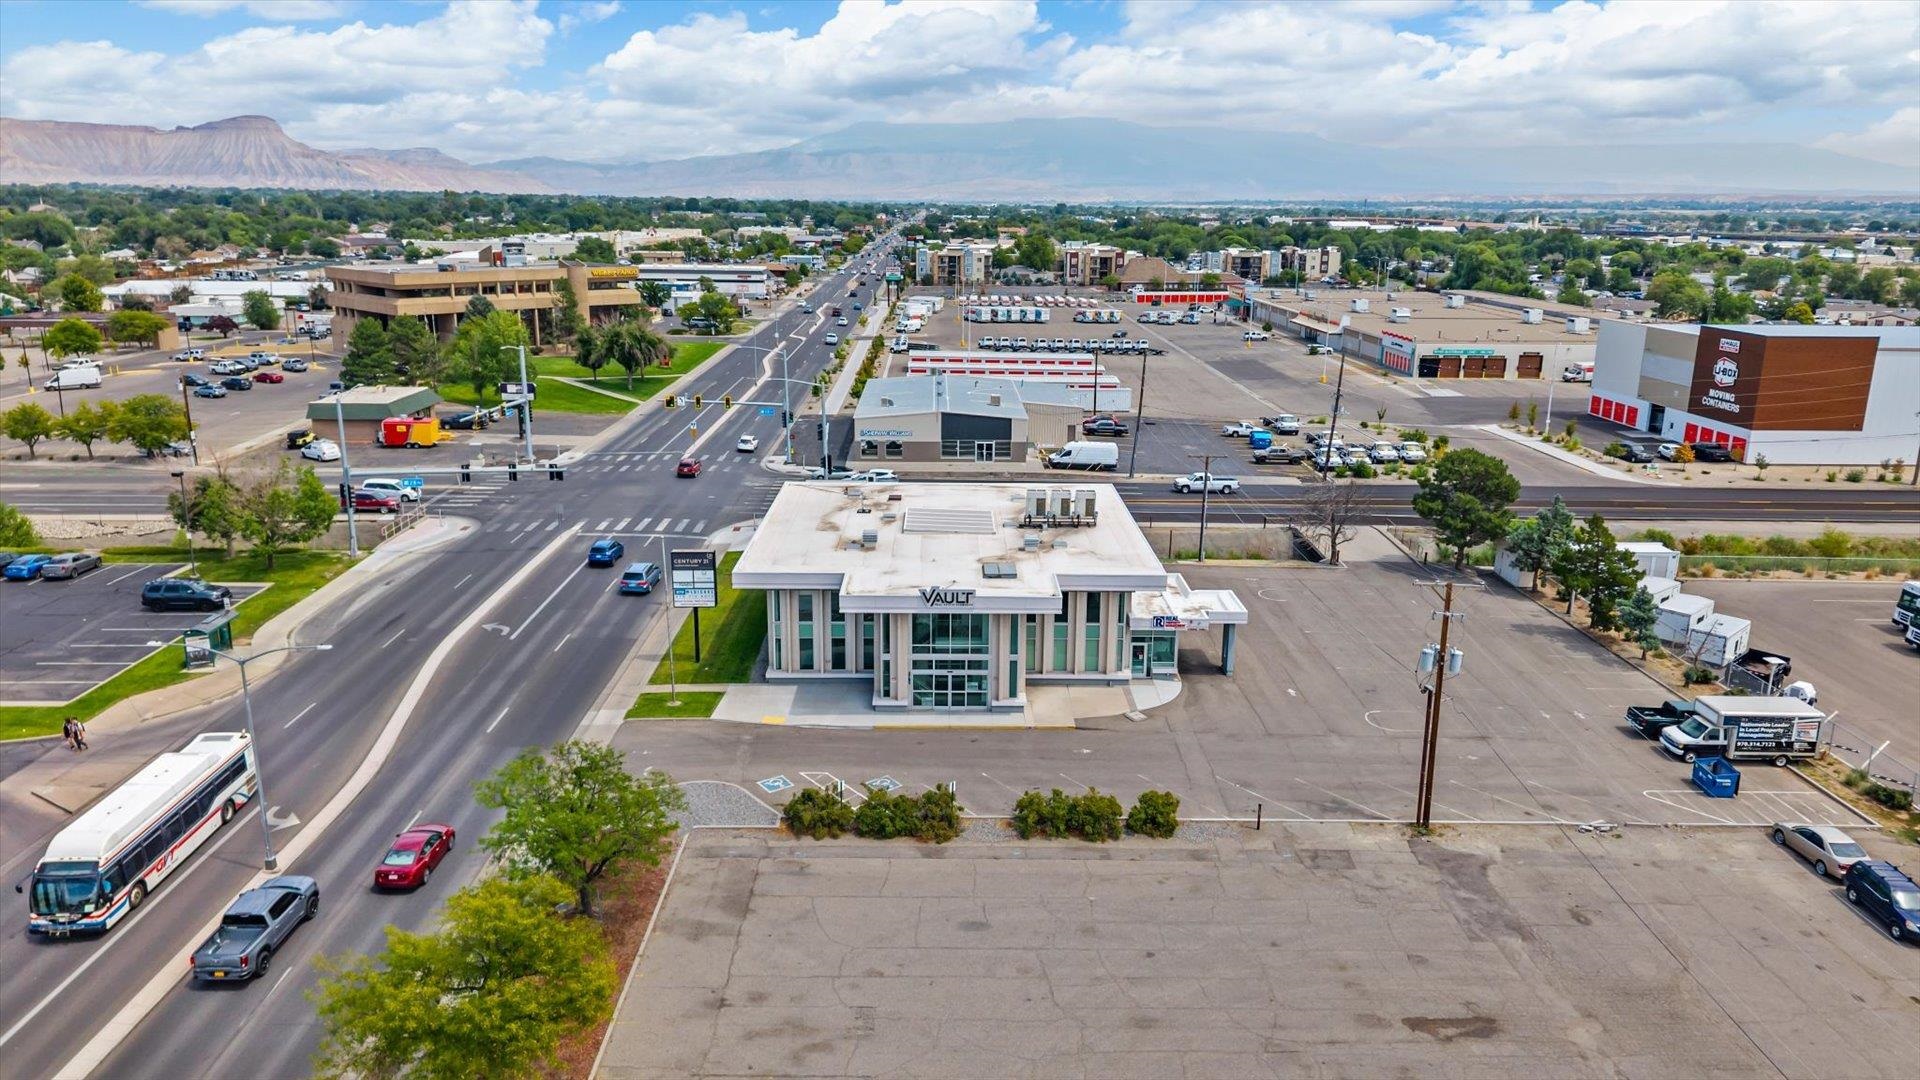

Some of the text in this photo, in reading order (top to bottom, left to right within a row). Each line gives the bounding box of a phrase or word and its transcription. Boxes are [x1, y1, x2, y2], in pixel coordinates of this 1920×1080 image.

[1715, 367, 1737, 377] U-BOX
[1709, 388, 1735, 402] MOVING
[1702, 396, 1740, 413] CONTAINERS
[922, 589, 973, 606] VAULT
